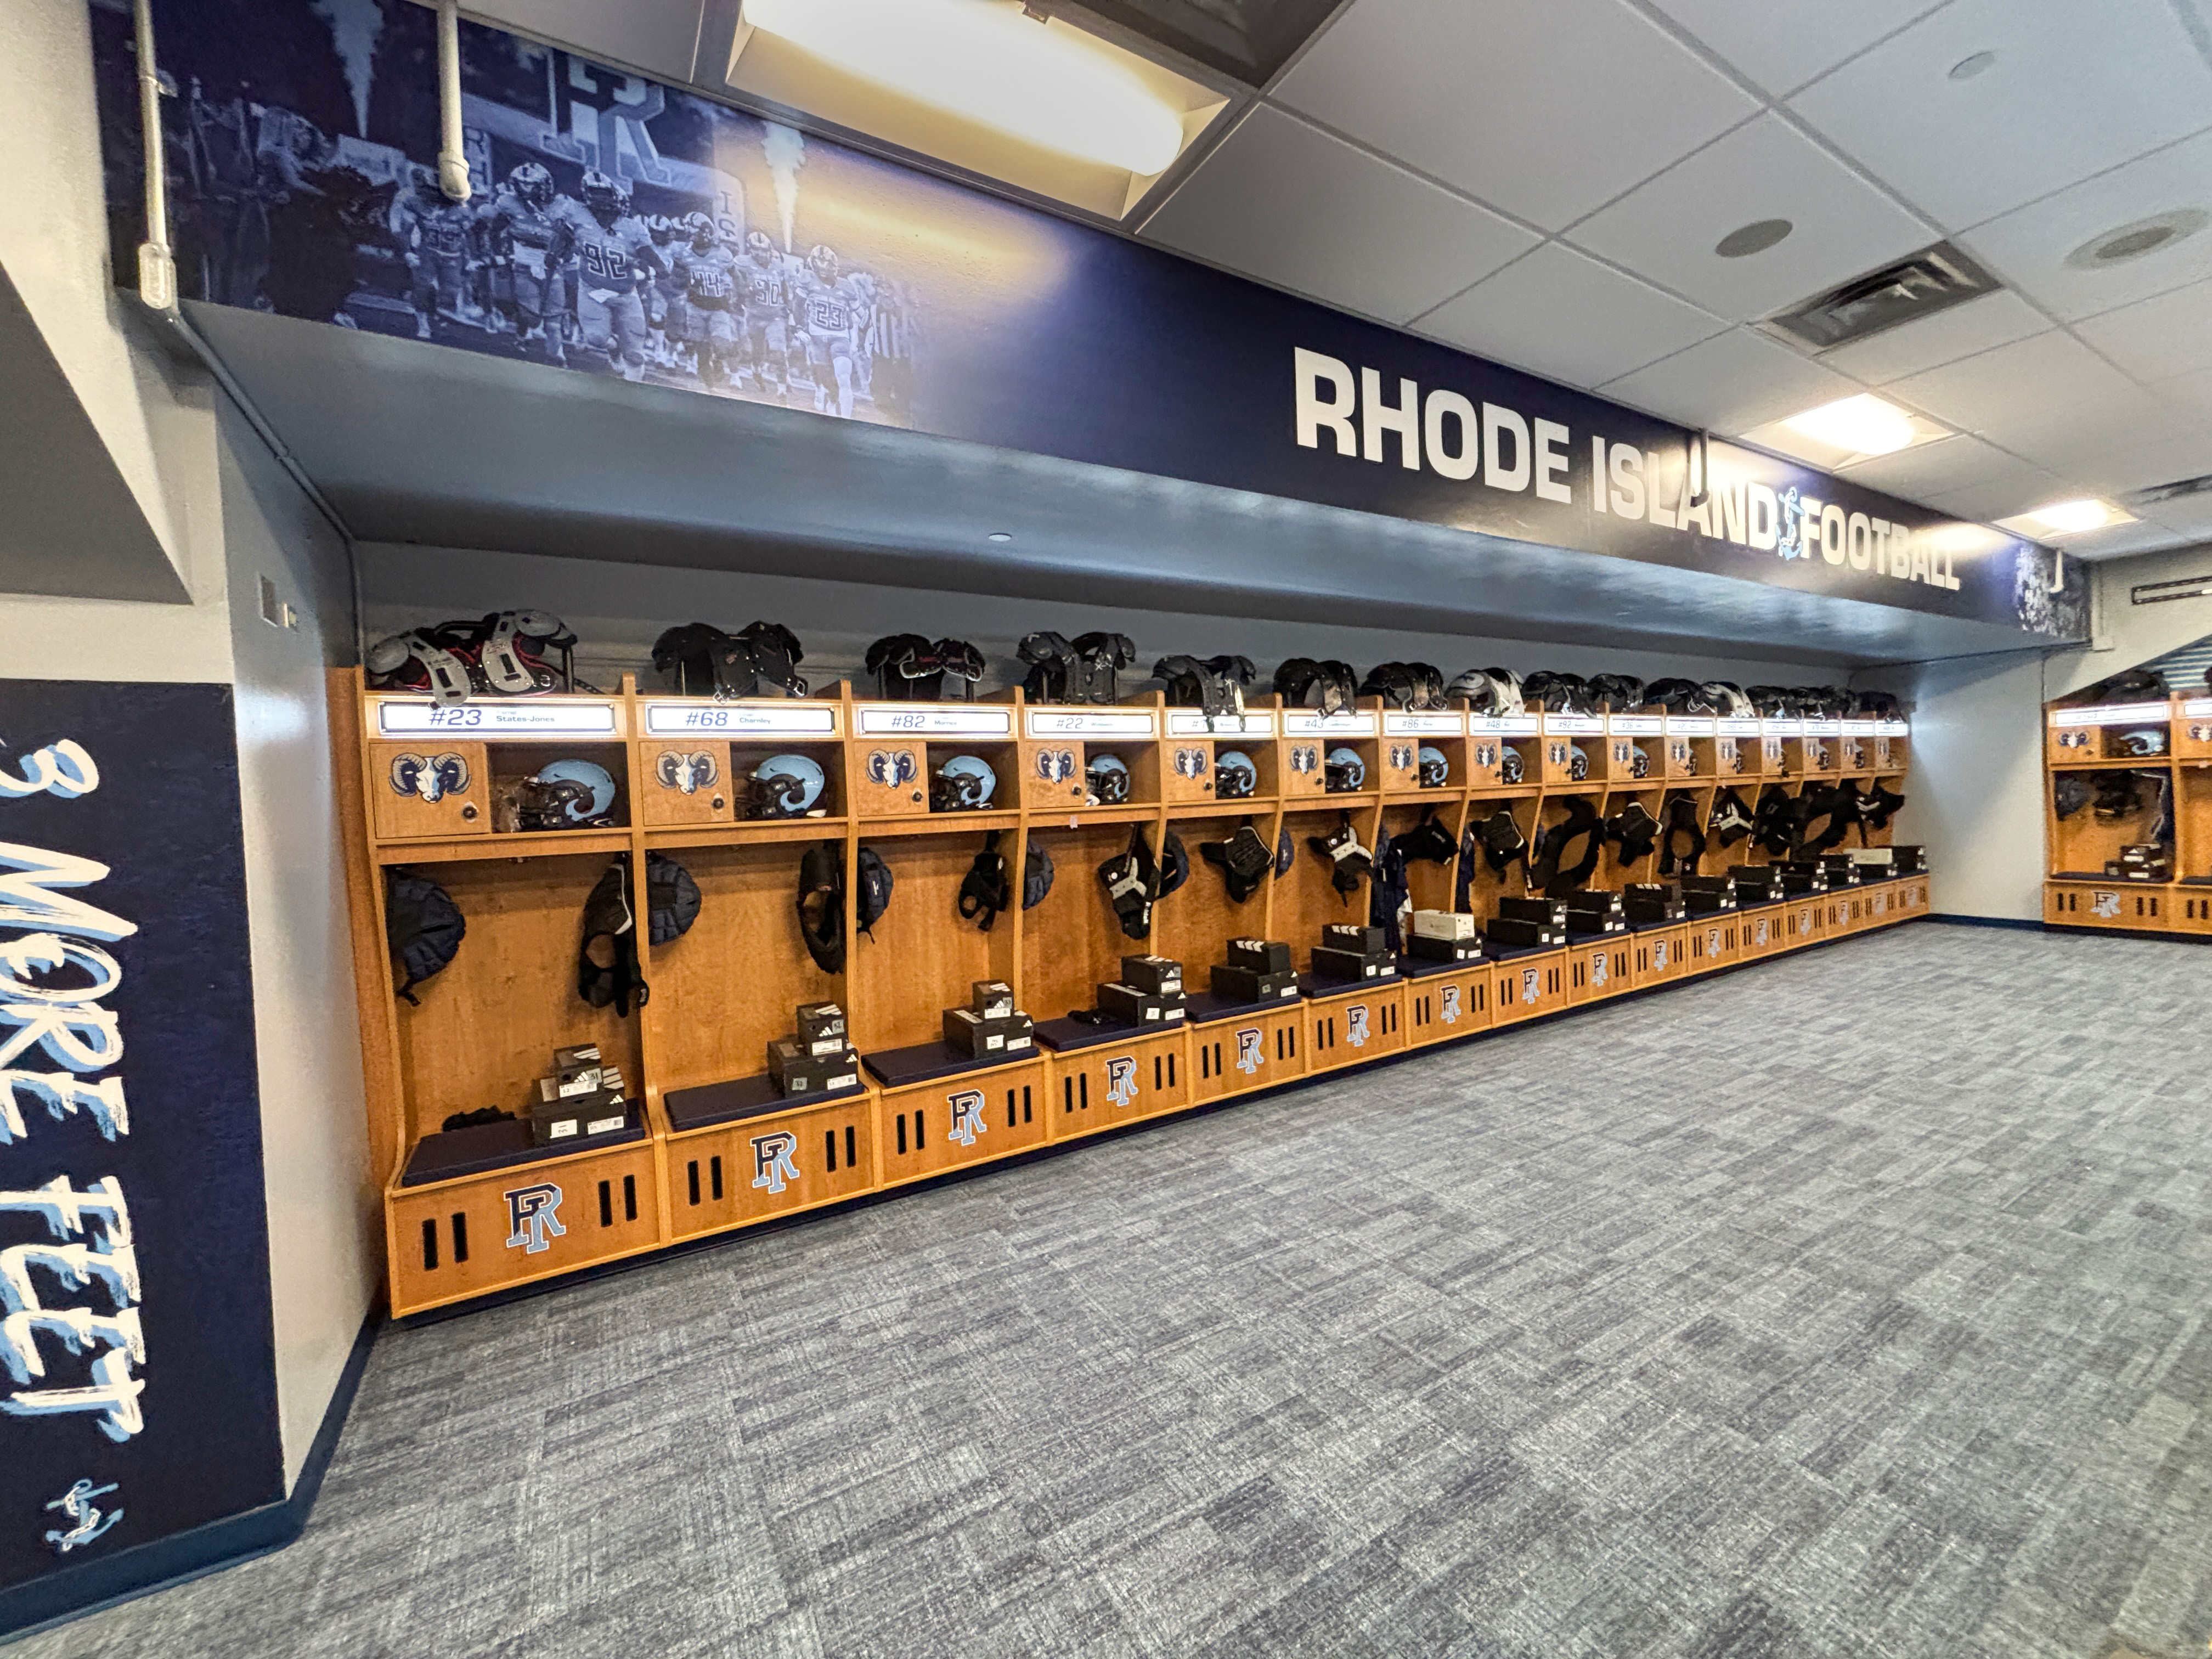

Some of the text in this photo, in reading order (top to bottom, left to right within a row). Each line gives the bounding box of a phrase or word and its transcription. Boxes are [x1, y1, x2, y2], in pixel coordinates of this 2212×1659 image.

[582, 241, 628, 280] 92
[1294, 346, 1961, 591] RHODE ISLAND FOOTBALL
[428, 709, 482, 726] #23
[685, 712, 729, 726] #68
[891, 715, 926, 728] #82
[1057, 718, 1084, 729] #22
[1402, 719, 1419, 729] #86
[1486, 720, 1500, 729] #48
[1558, 720, 1572, 729] #92
[0, 841, 138, 1145] MORE
[0, 1175, 146, 1443] FEET
